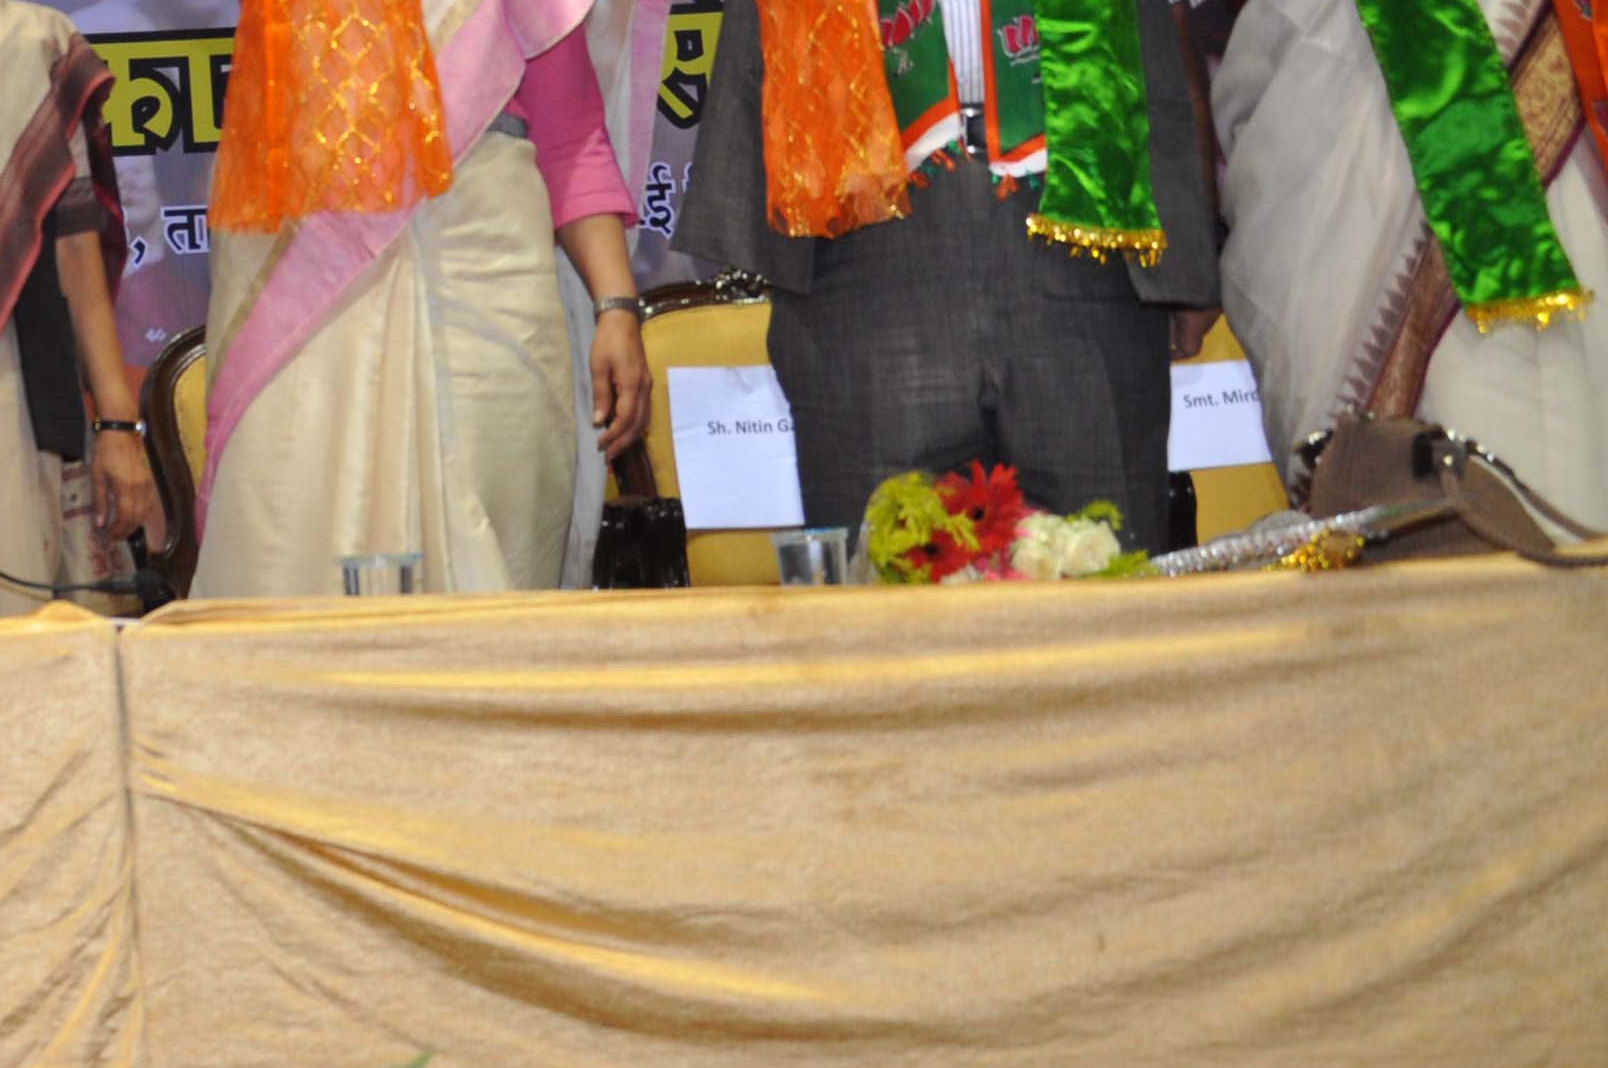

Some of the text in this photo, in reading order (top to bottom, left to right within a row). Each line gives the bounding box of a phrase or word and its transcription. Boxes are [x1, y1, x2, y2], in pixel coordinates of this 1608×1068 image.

[1182, 393, 1220, 409] Smt.
[706, 420, 732, 436] Sh.
[734, 419, 774, 435] Nitin
